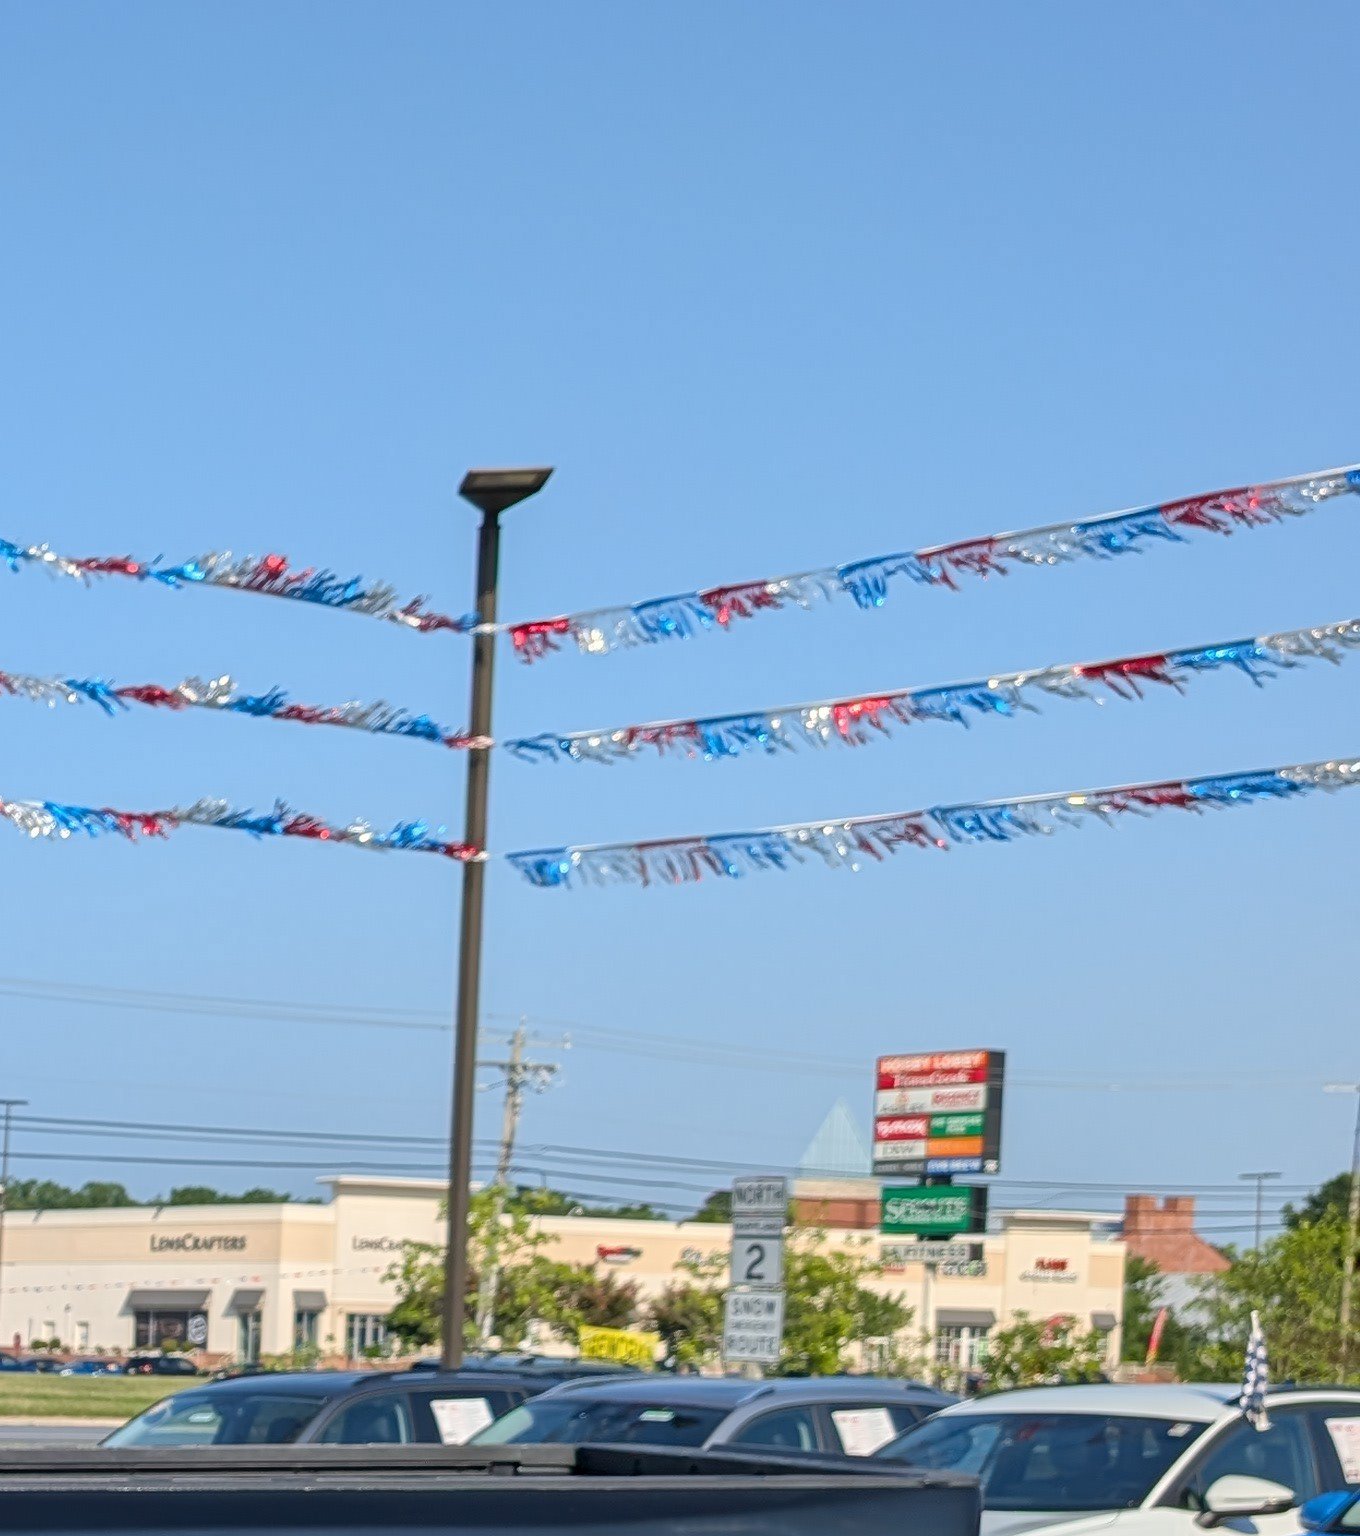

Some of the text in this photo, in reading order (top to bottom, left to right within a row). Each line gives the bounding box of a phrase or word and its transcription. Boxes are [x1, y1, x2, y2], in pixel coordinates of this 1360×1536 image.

[735, 1184, 781, 1204] NORTH
[745, 1243, 766, 1280] 2
[733, 1297, 776, 1315] SNOW
[728, 1335, 778, 1354] ROUTE
